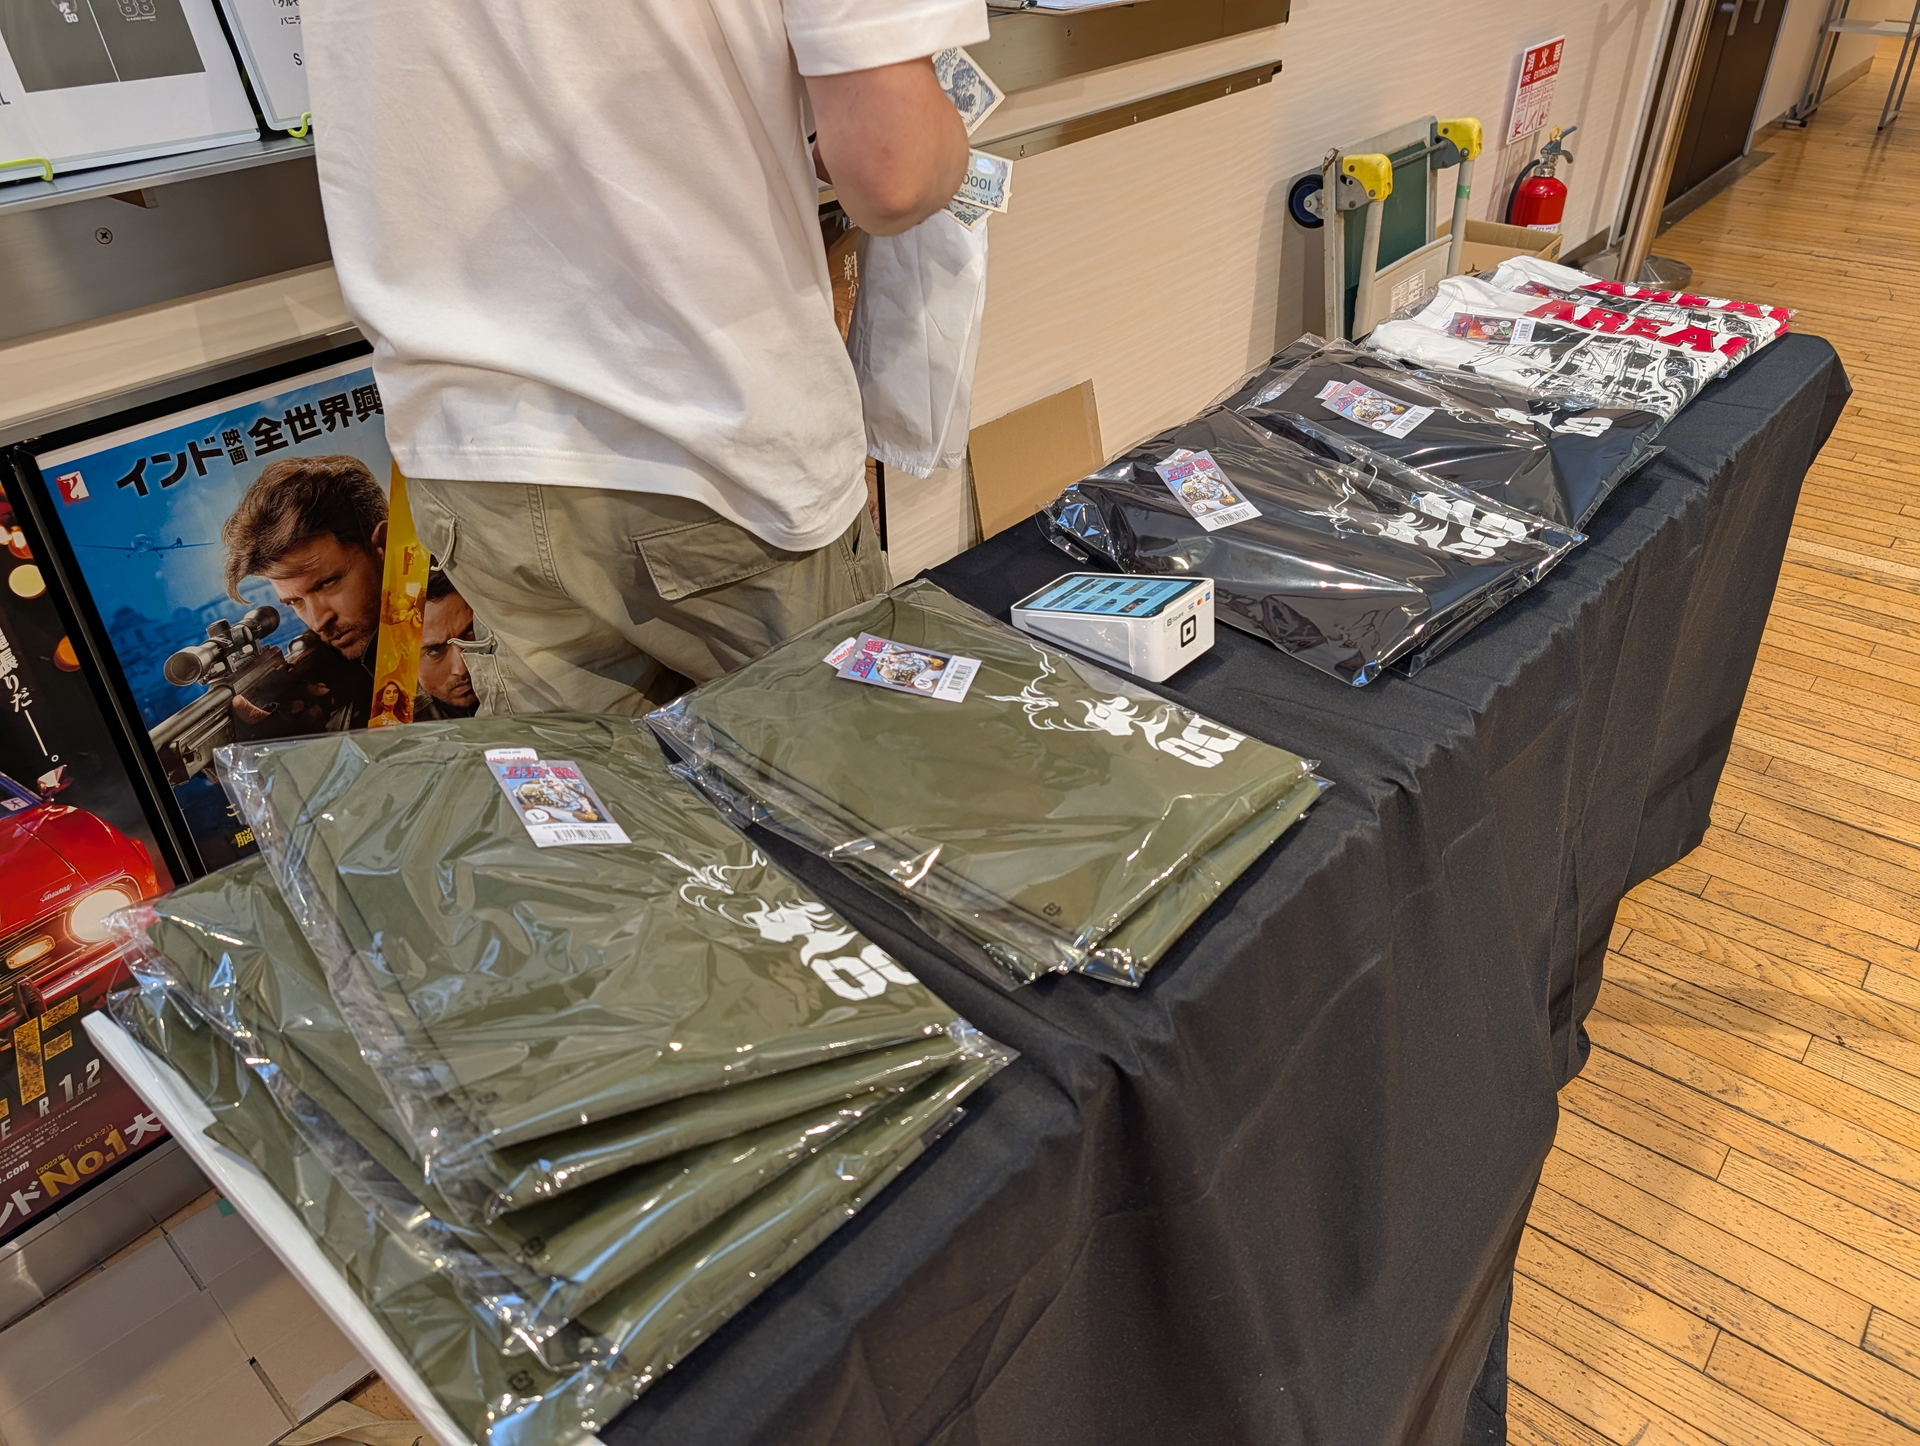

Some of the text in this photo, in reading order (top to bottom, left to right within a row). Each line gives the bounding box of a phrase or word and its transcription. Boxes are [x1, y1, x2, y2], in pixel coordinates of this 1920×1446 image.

[1525, 43, 1562, 73] 消火器
[953, 210, 976, 227] 1000
[1523, 299, 1720, 352] AREA
[531, 812, 545, 821] L
[0, 1160, 30, 1184] .com
